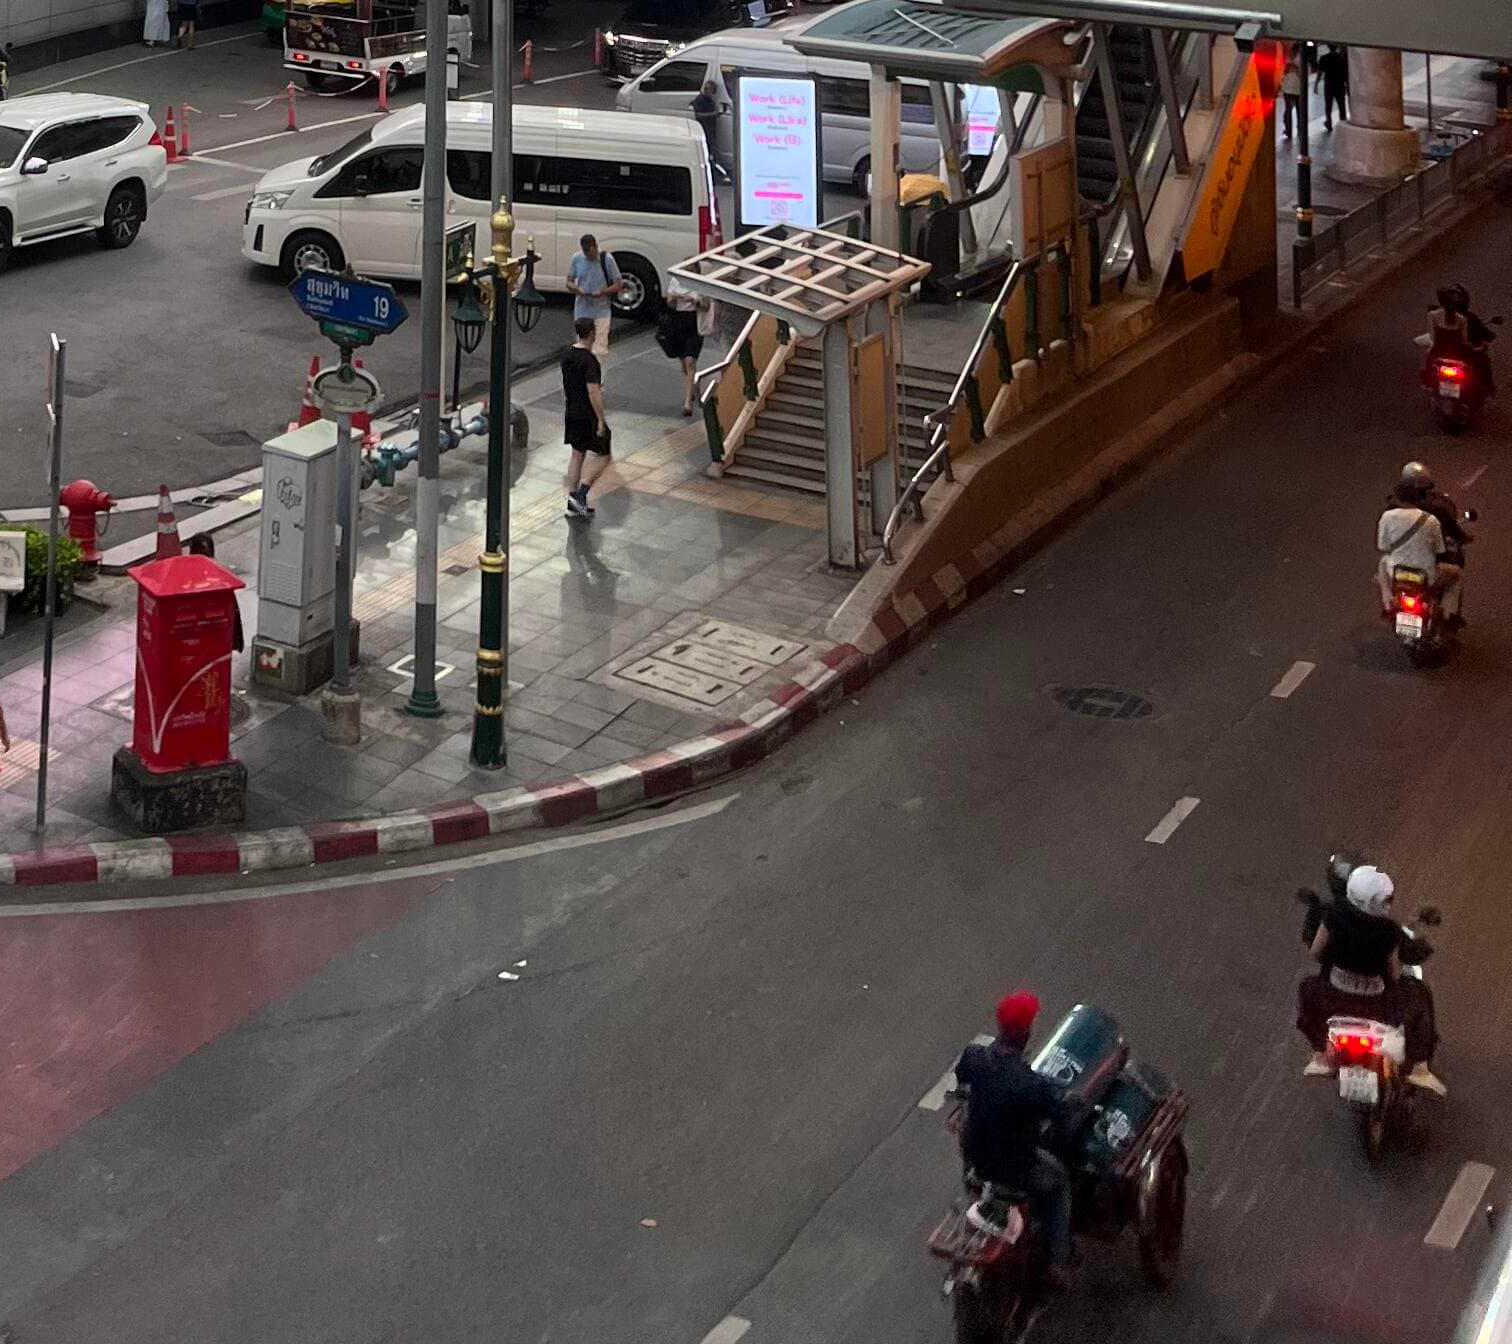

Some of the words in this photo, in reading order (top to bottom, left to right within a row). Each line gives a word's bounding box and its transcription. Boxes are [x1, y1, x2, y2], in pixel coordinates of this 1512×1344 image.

[748, 93, 776, 104] Work
[748, 114, 775, 125] Work
[753, 133, 780, 145] Work
[306, 278, 350, 300] สุขุมวิท
[373, 295, 390, 319] 19
